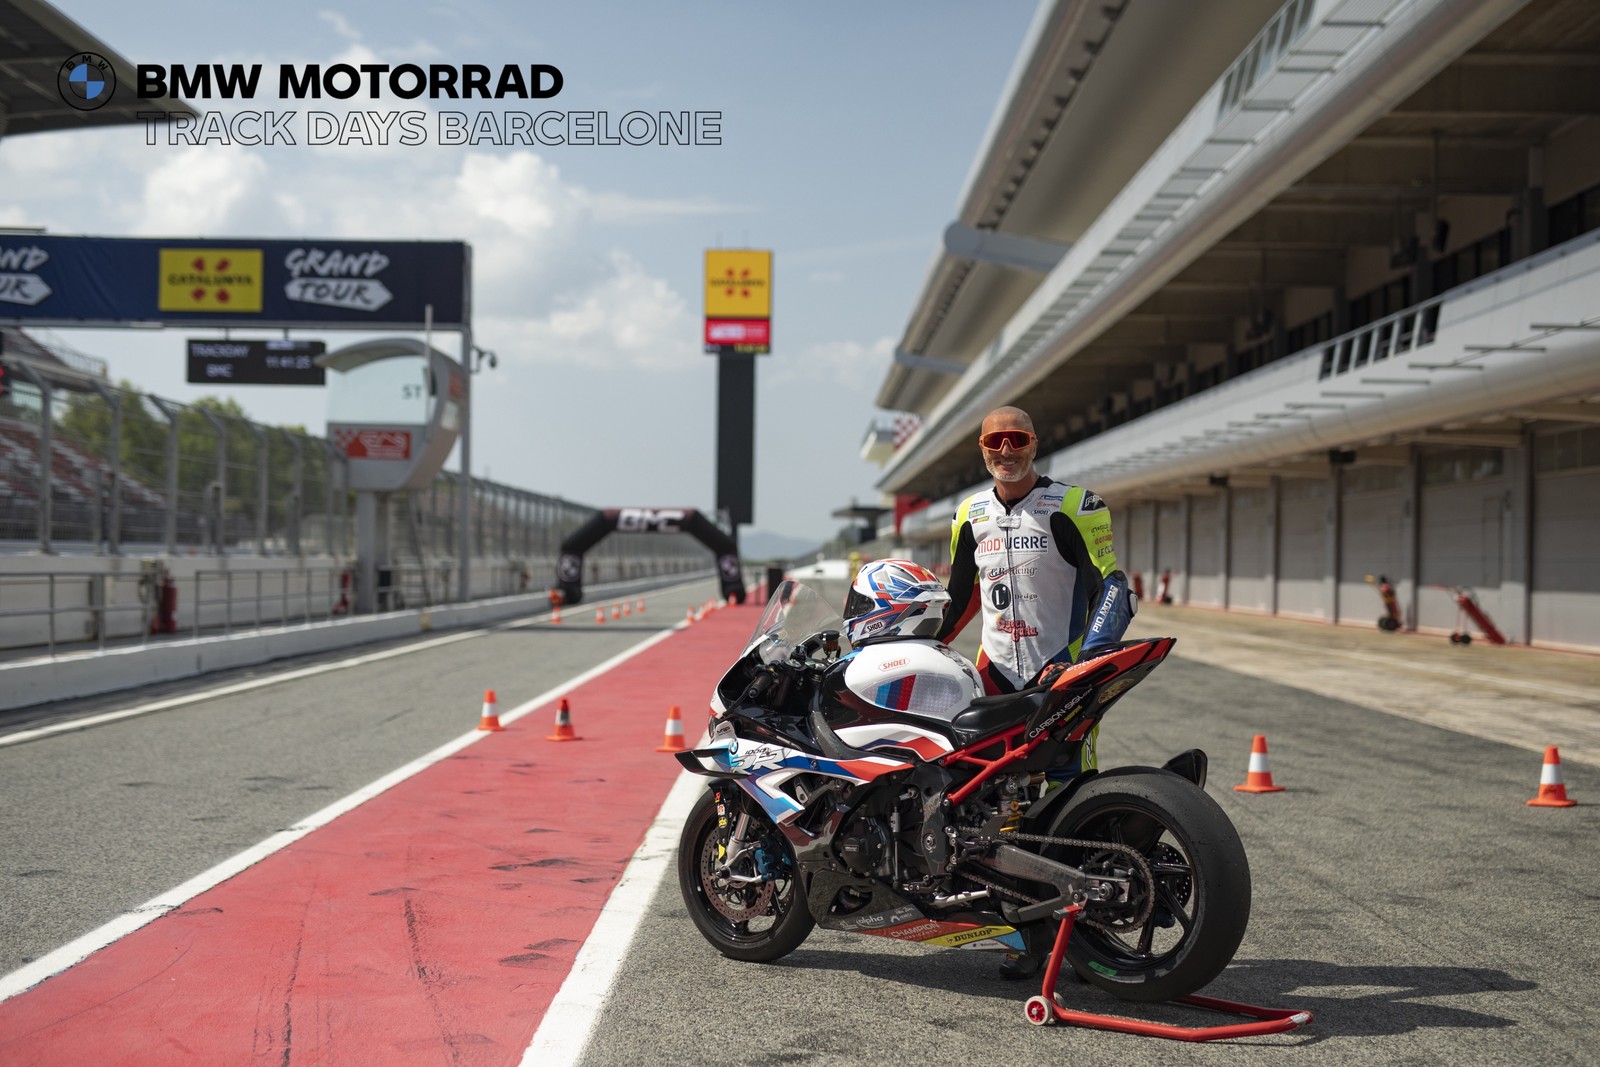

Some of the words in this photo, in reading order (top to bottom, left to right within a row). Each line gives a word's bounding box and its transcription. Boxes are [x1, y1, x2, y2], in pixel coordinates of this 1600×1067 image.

[285, 247, 390, 278] GRAND
[298, 282, 374, 305] TOUR
[867, 621, 884, 632] SHOEI
[882, 658, 907, 669] SHOEI
[858, 915, 884, 927] alpha
[890, 922, 940, 938] CHAMPION
[954, 928, 993, 942] DUNLOP
